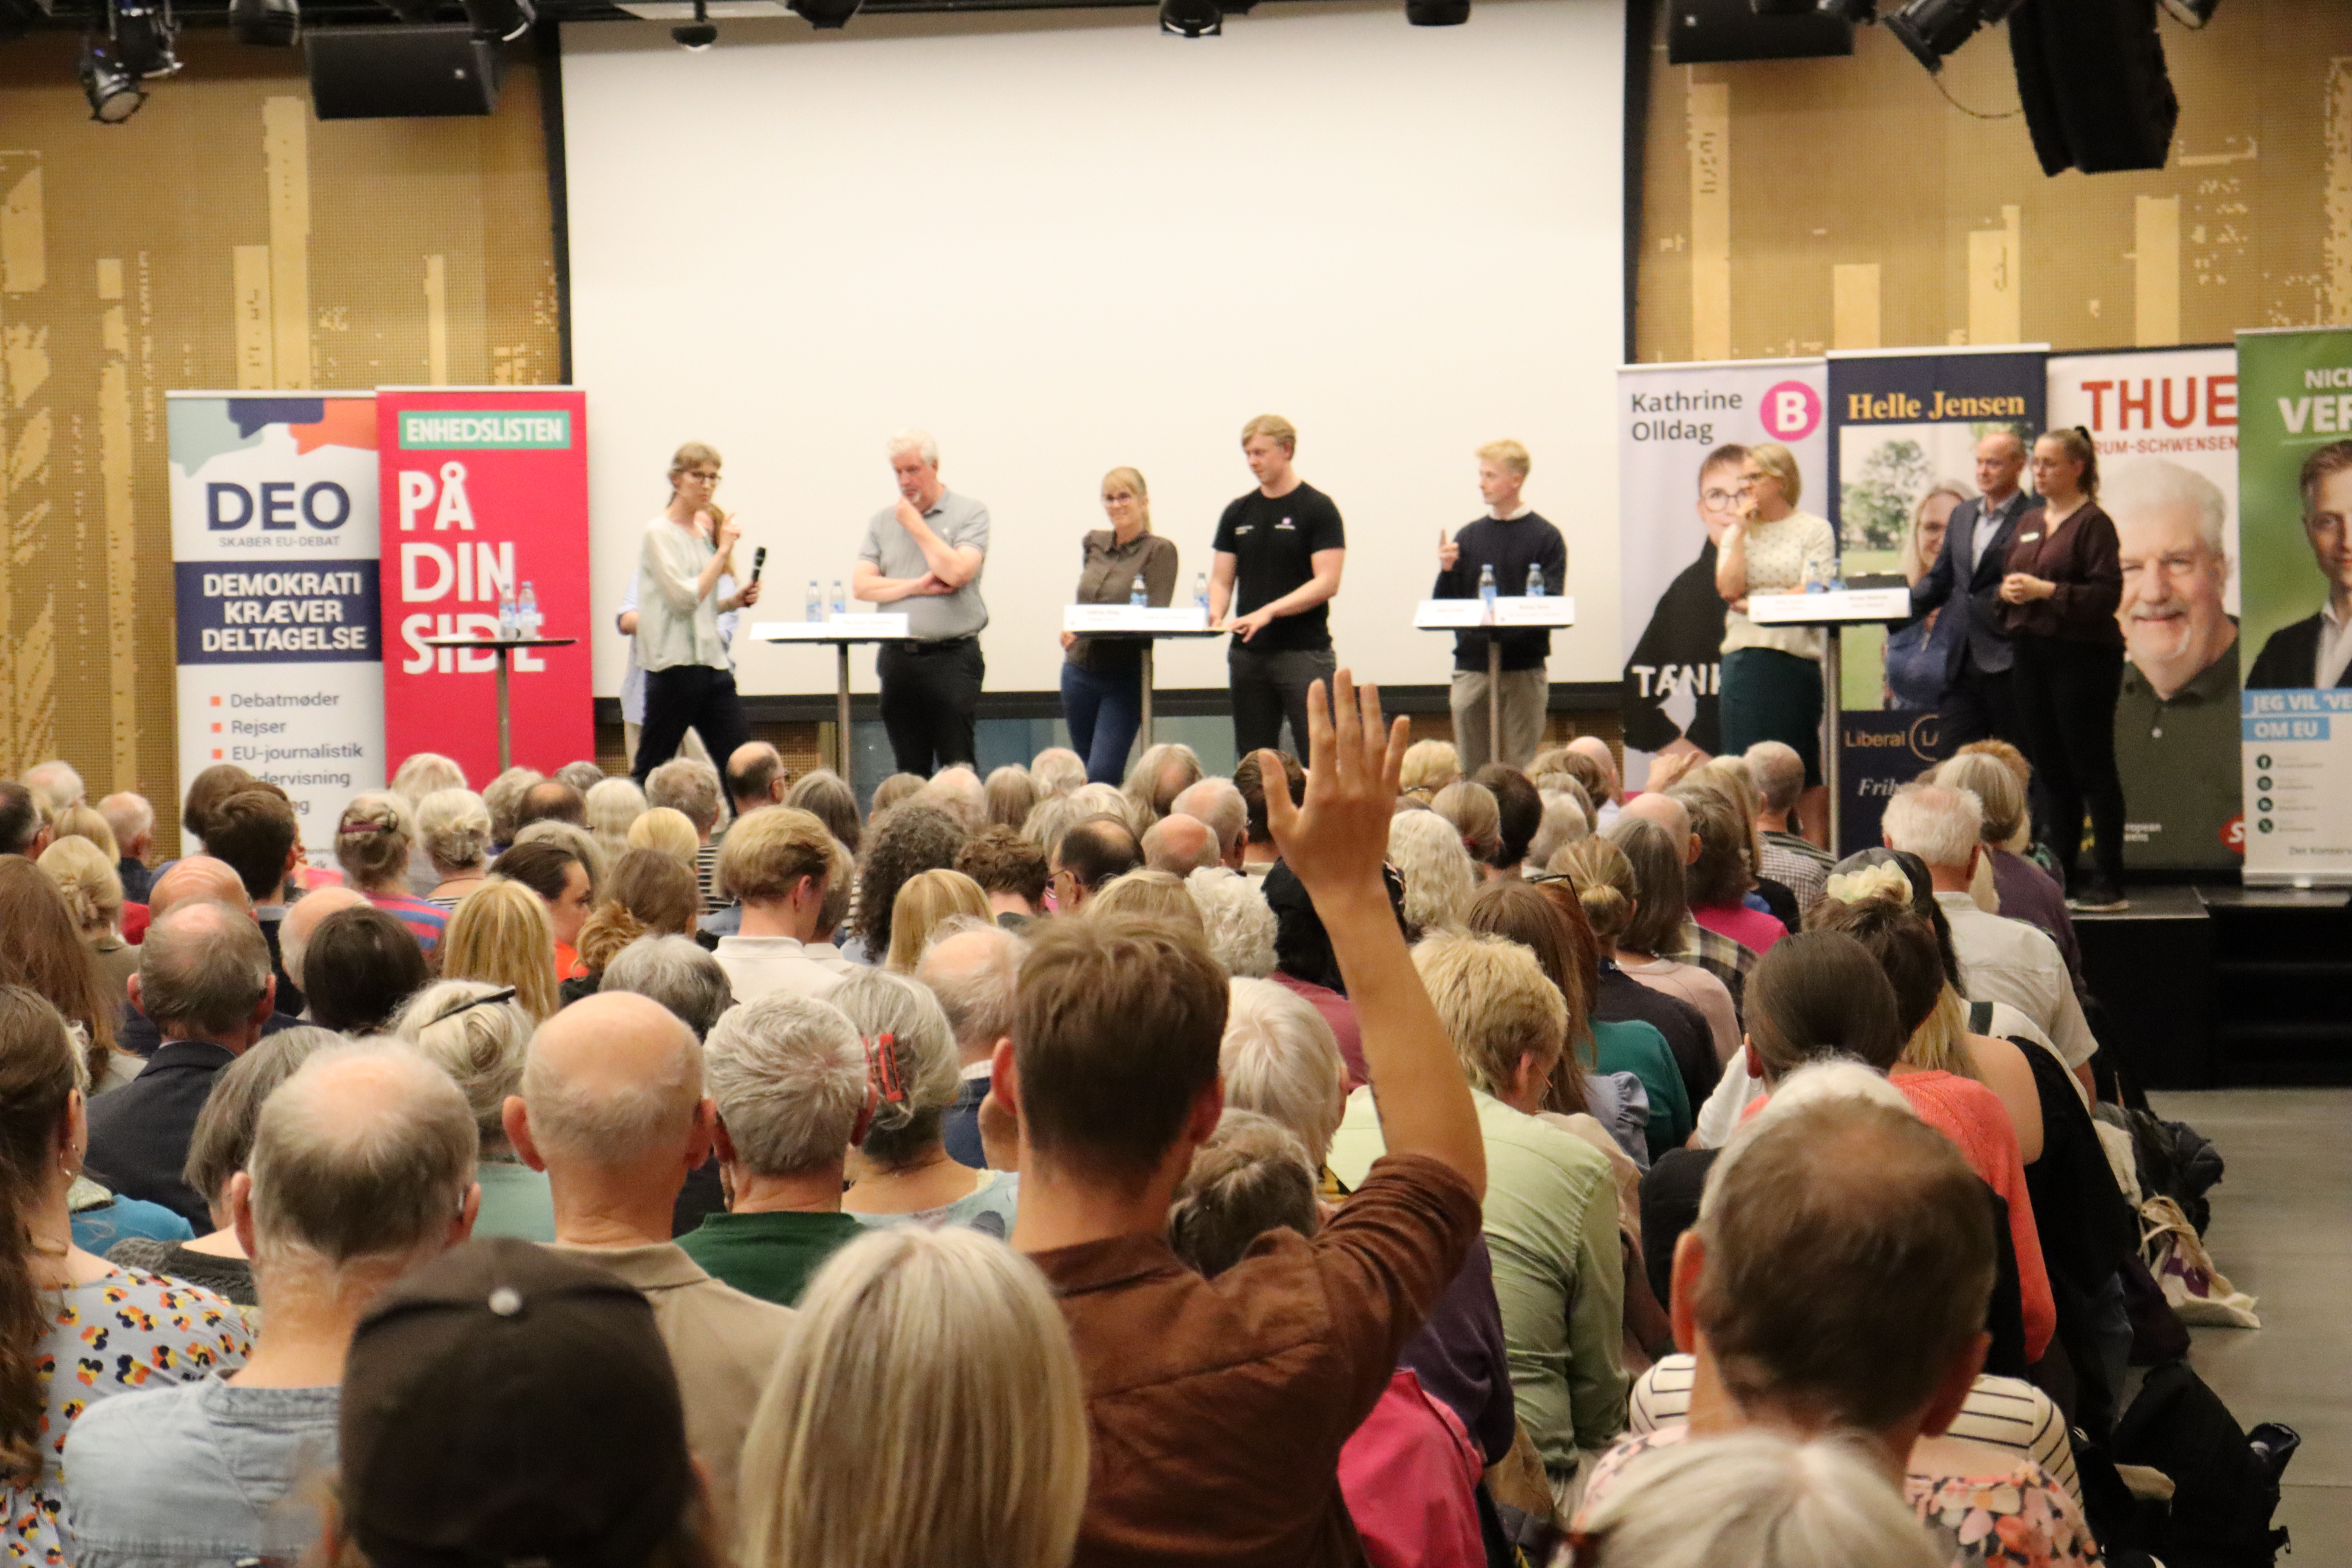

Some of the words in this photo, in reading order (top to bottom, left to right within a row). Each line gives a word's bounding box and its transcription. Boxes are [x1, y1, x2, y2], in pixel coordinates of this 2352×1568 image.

[1632, 390, 1742, 412] Kathrine
[1777, 392, 1807, 431] B
[1848, 393, 1921, 419] Helle
[1928, 392, 2024, 419] Jensen
[2081, 375, 2237, 431] THUE
[407, 418, 563, 442] ENHEDSLISTEN
[1632, 420, 1714, 445] Olldag
[2095, 436, 2238, 455] RUM-SCHWENSEN
[207, 481, 351, 531] DEO
[399, 461, 475, 530] PÅ
[218, 537, 272, 547] SKABER
[276, 535, 340, 546] EU-DEBAT
[401, 542, 514, 603] DIN
[203, 572, 361, 597] DEMOKRATI
[225, 600, 343, 624] KRÆVER
[202, 627, 367, 652] DELTAGELSE
[230, 692, 339, 707] Debatmøder
[2251, 695, 2284, 716] JEG
[2287, 695, 2320, 710] VIL
[232, 720, 286, 737] Rejser
[1845, 731, 1906, 747] Liberal
[2255, 722, 2288, 738] OM
[2293, 721, 2318, 738] EU
[232, 744, 363, 762] EU-journalistik
[258, 771, 350, 787] dervisning
[2229, 822, 2244, 843] S
